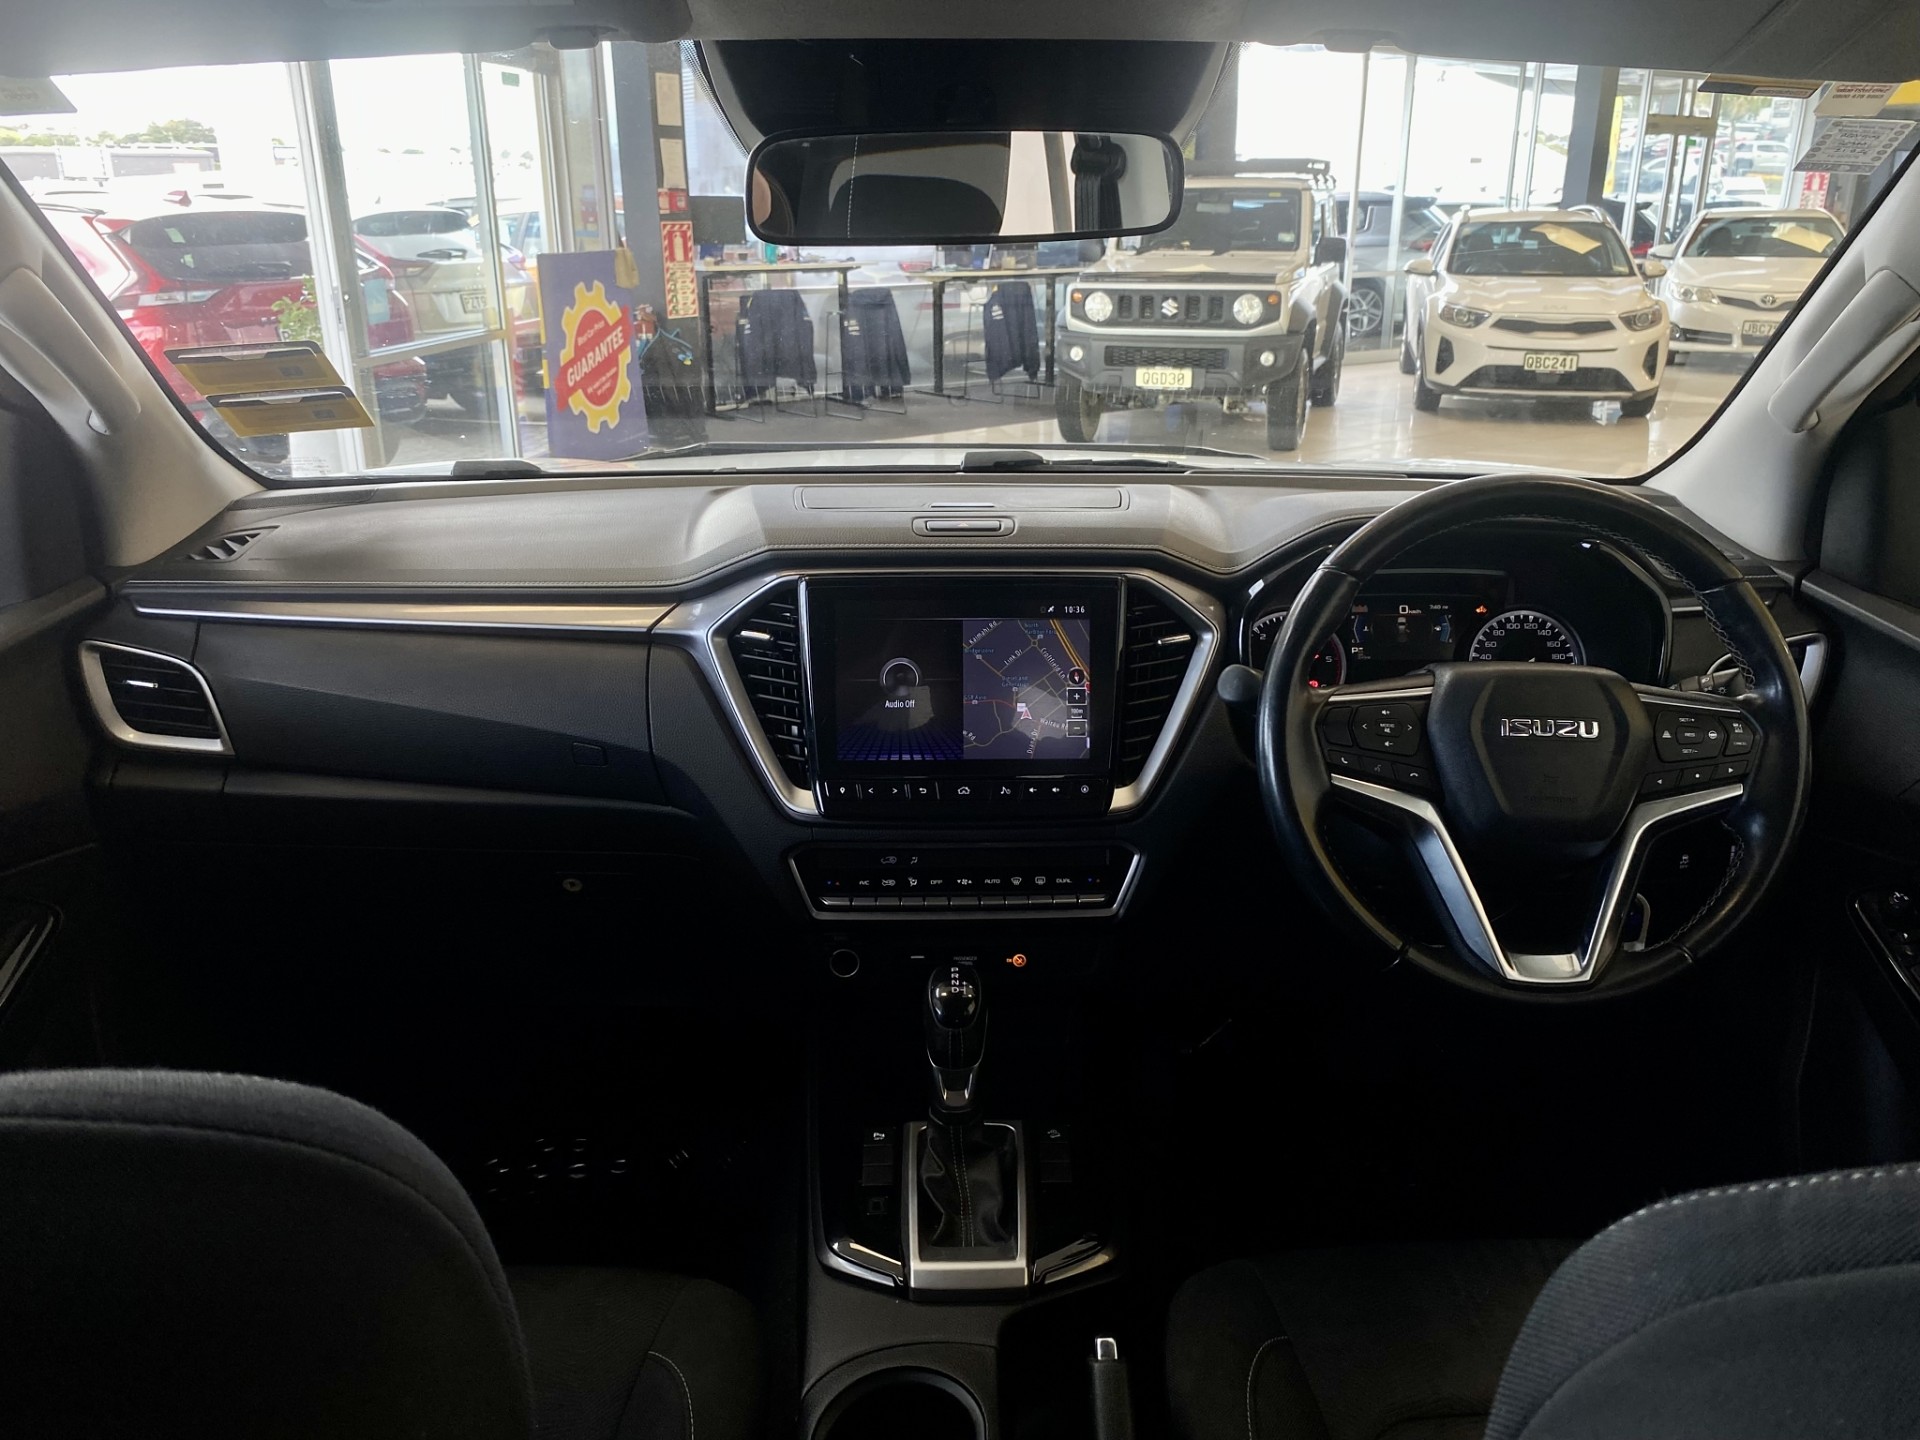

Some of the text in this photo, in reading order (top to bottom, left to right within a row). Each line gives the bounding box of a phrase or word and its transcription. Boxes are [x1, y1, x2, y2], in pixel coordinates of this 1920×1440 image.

[567, 326, 624, 388] GUARANTEE
[1526, 354, 1575, 370] QBC241
[1064, 606, 1085, 614] 10:36
[885, 700, 915, 708] Audio Off
[1500, 718, 1600, 738] ISUZU
